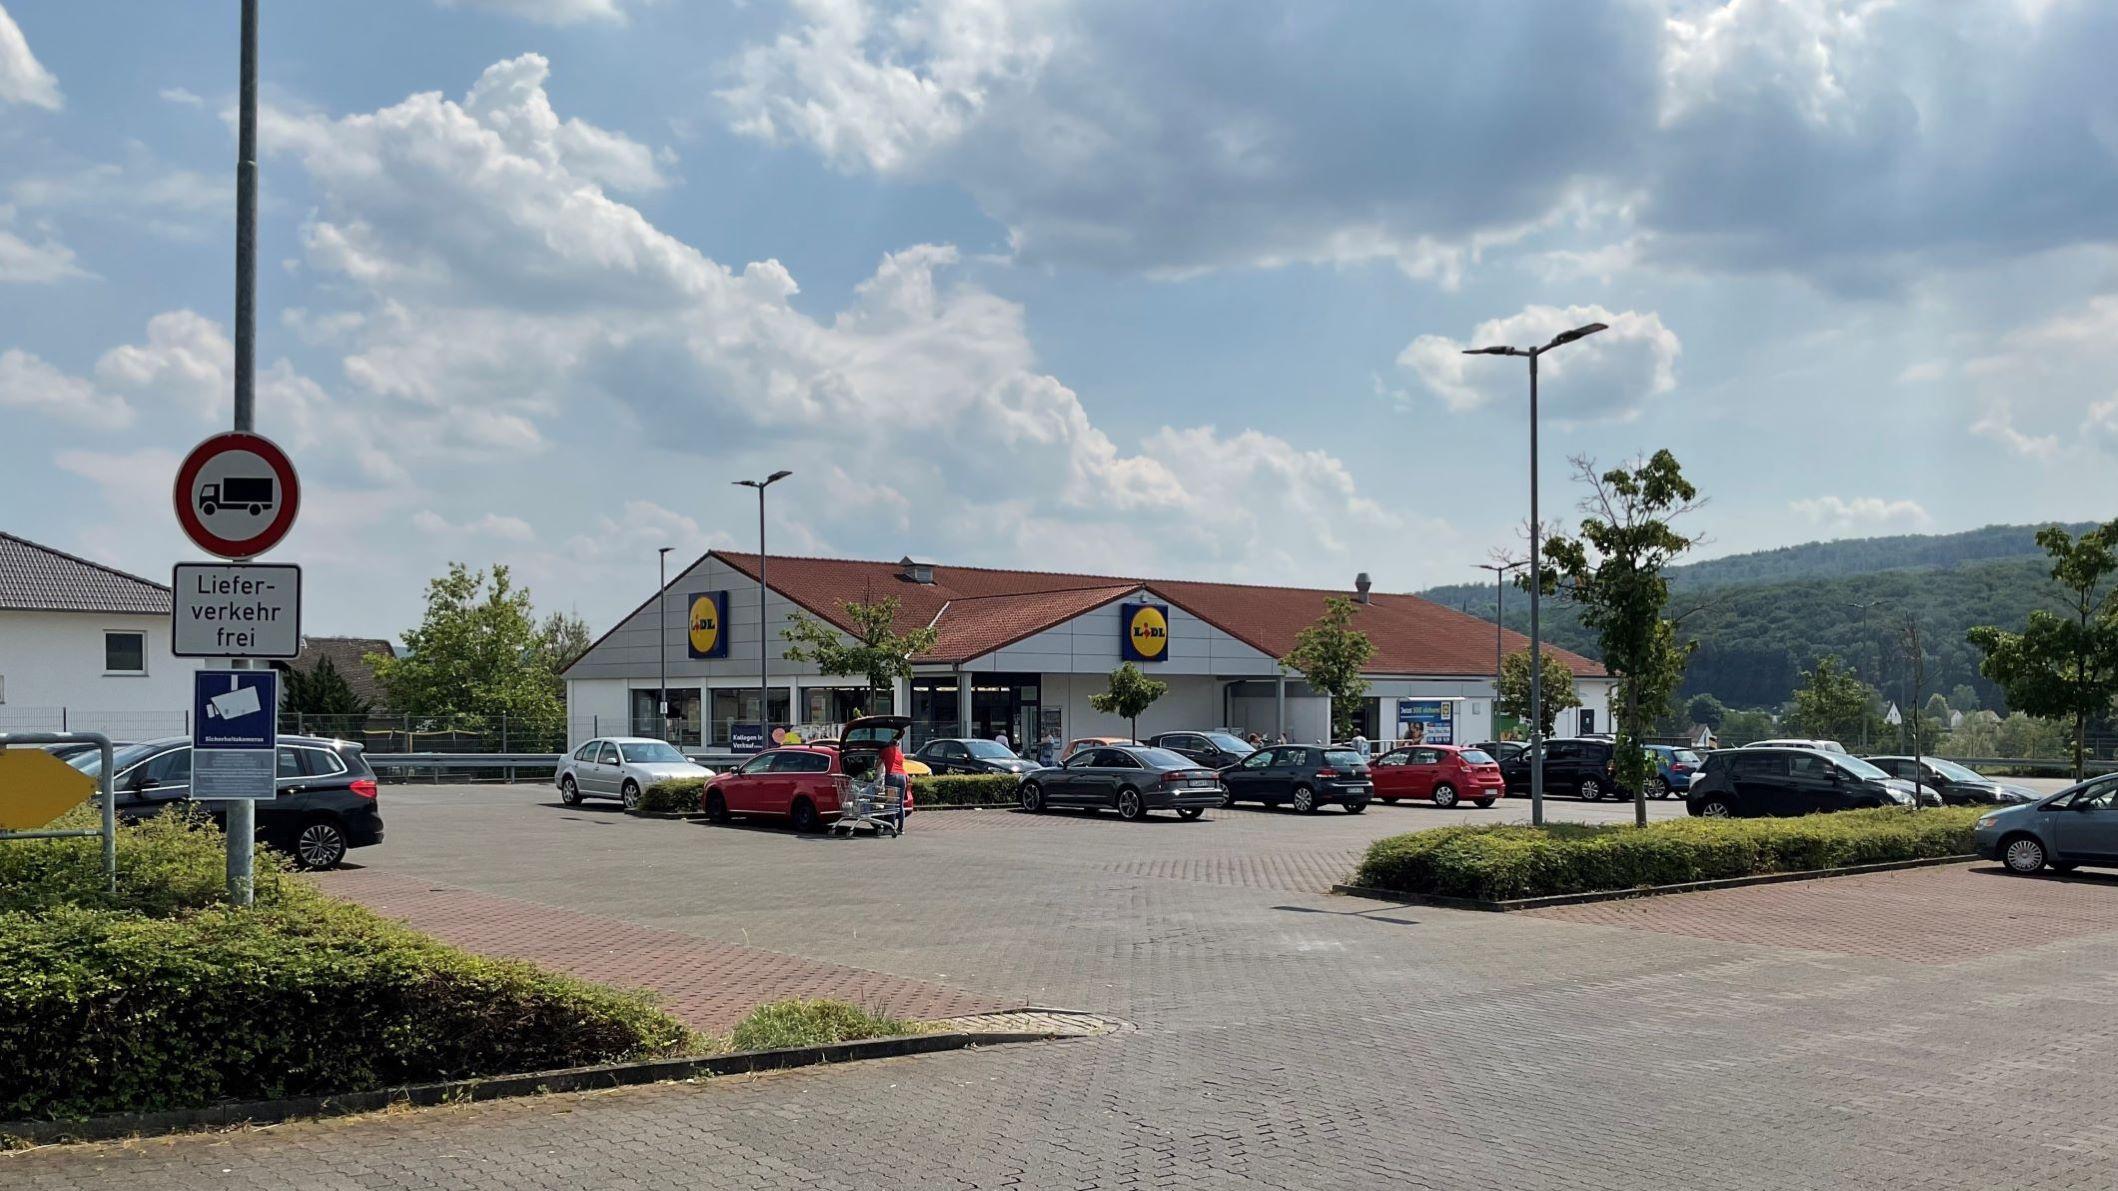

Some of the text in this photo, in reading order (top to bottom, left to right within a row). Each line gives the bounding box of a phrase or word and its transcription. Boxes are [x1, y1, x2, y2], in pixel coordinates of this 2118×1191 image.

[198, 574, 276, 595] Liefer-
[191, 601, 281, 621] verkehr
[217, 627, 255, 647] frei
[732, 734, 757, 742] Kollegen
